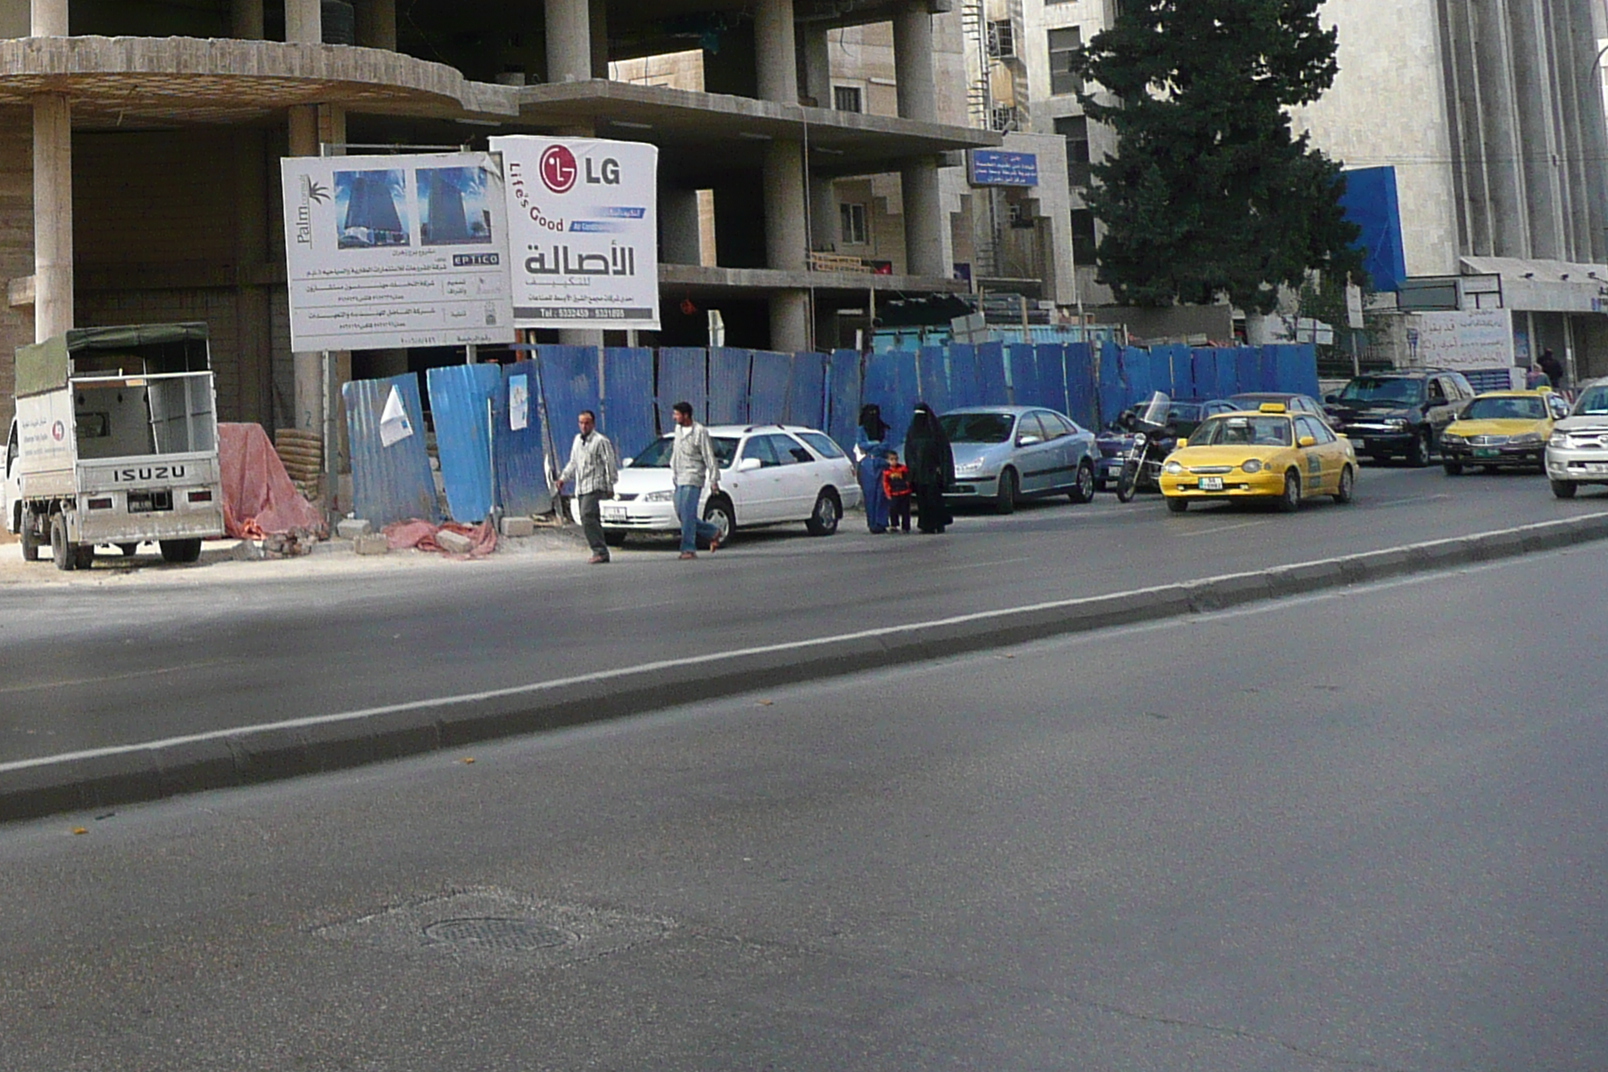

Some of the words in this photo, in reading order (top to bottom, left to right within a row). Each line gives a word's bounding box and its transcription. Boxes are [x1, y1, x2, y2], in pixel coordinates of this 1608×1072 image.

[585, 157, 620, 185] LG
[509, 162, 529, 208] Life's
[529, 206, 564, 232] Good
[296, 206, 310, 244] Palm
[524, 239, 634, 276] الأصالة
[540, 309, 552, 317] Tel
[114, 465, 186, 482] ISUZU
